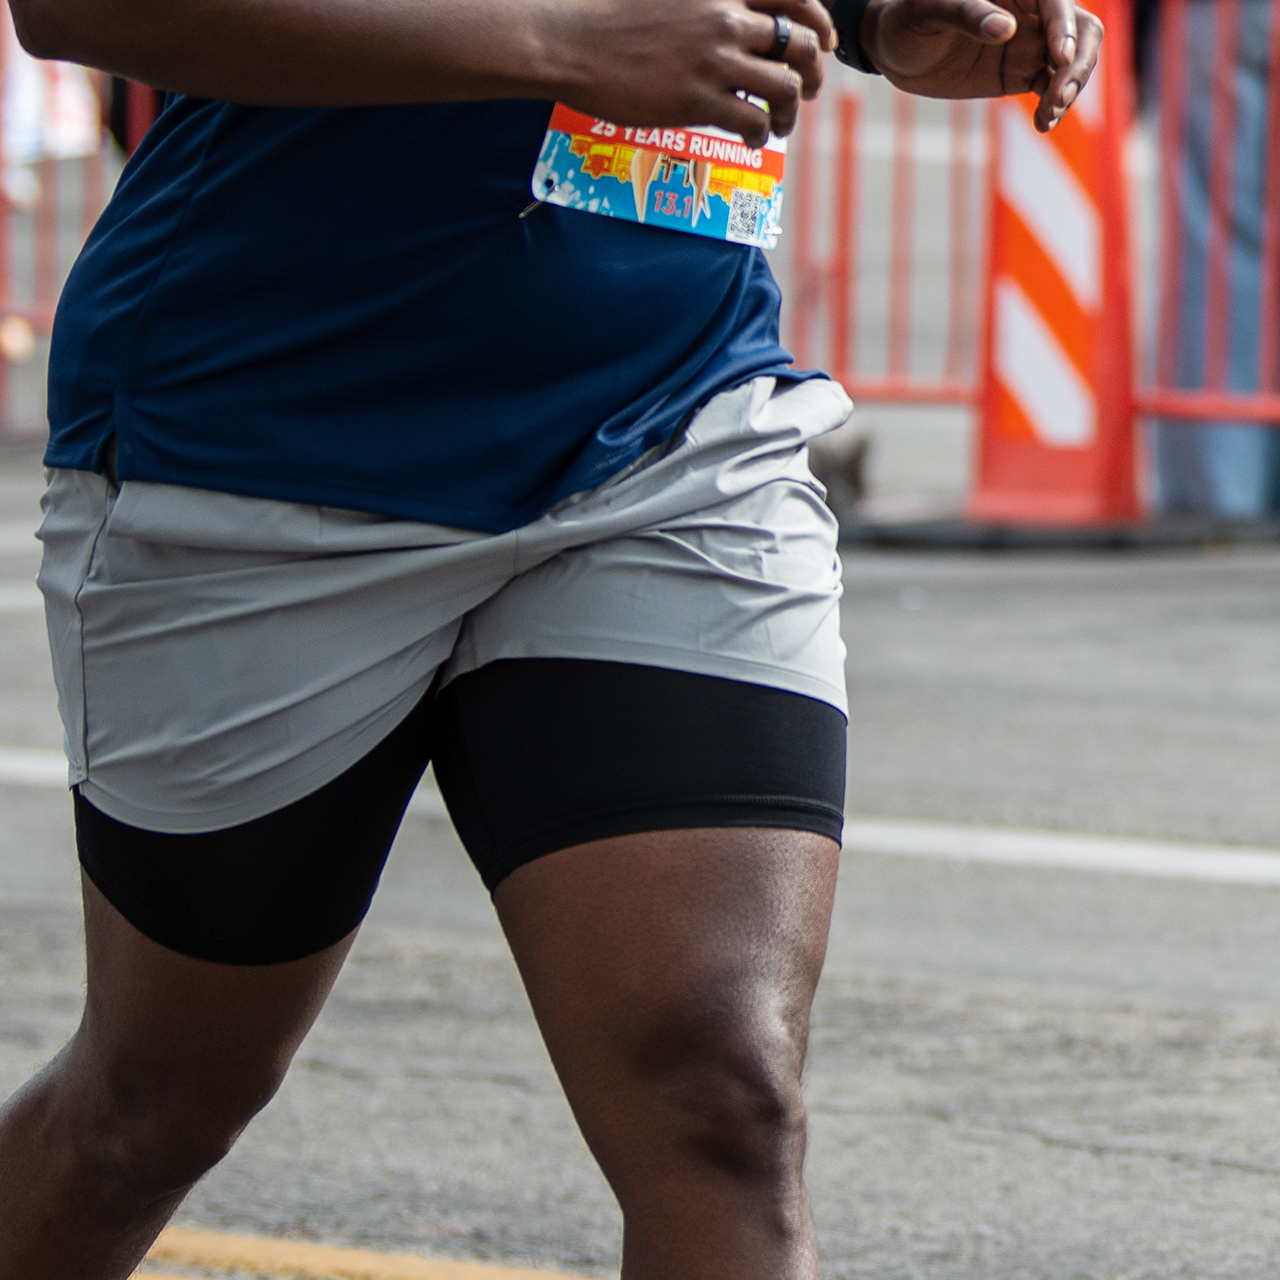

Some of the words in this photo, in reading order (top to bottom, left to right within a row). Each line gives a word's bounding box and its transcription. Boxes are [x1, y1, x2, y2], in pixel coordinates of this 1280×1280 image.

[624, 127, 686, 152] YEARS
[689, 136, 763, 169] RUNNING
[654, 190, 693, 219] 13.1
